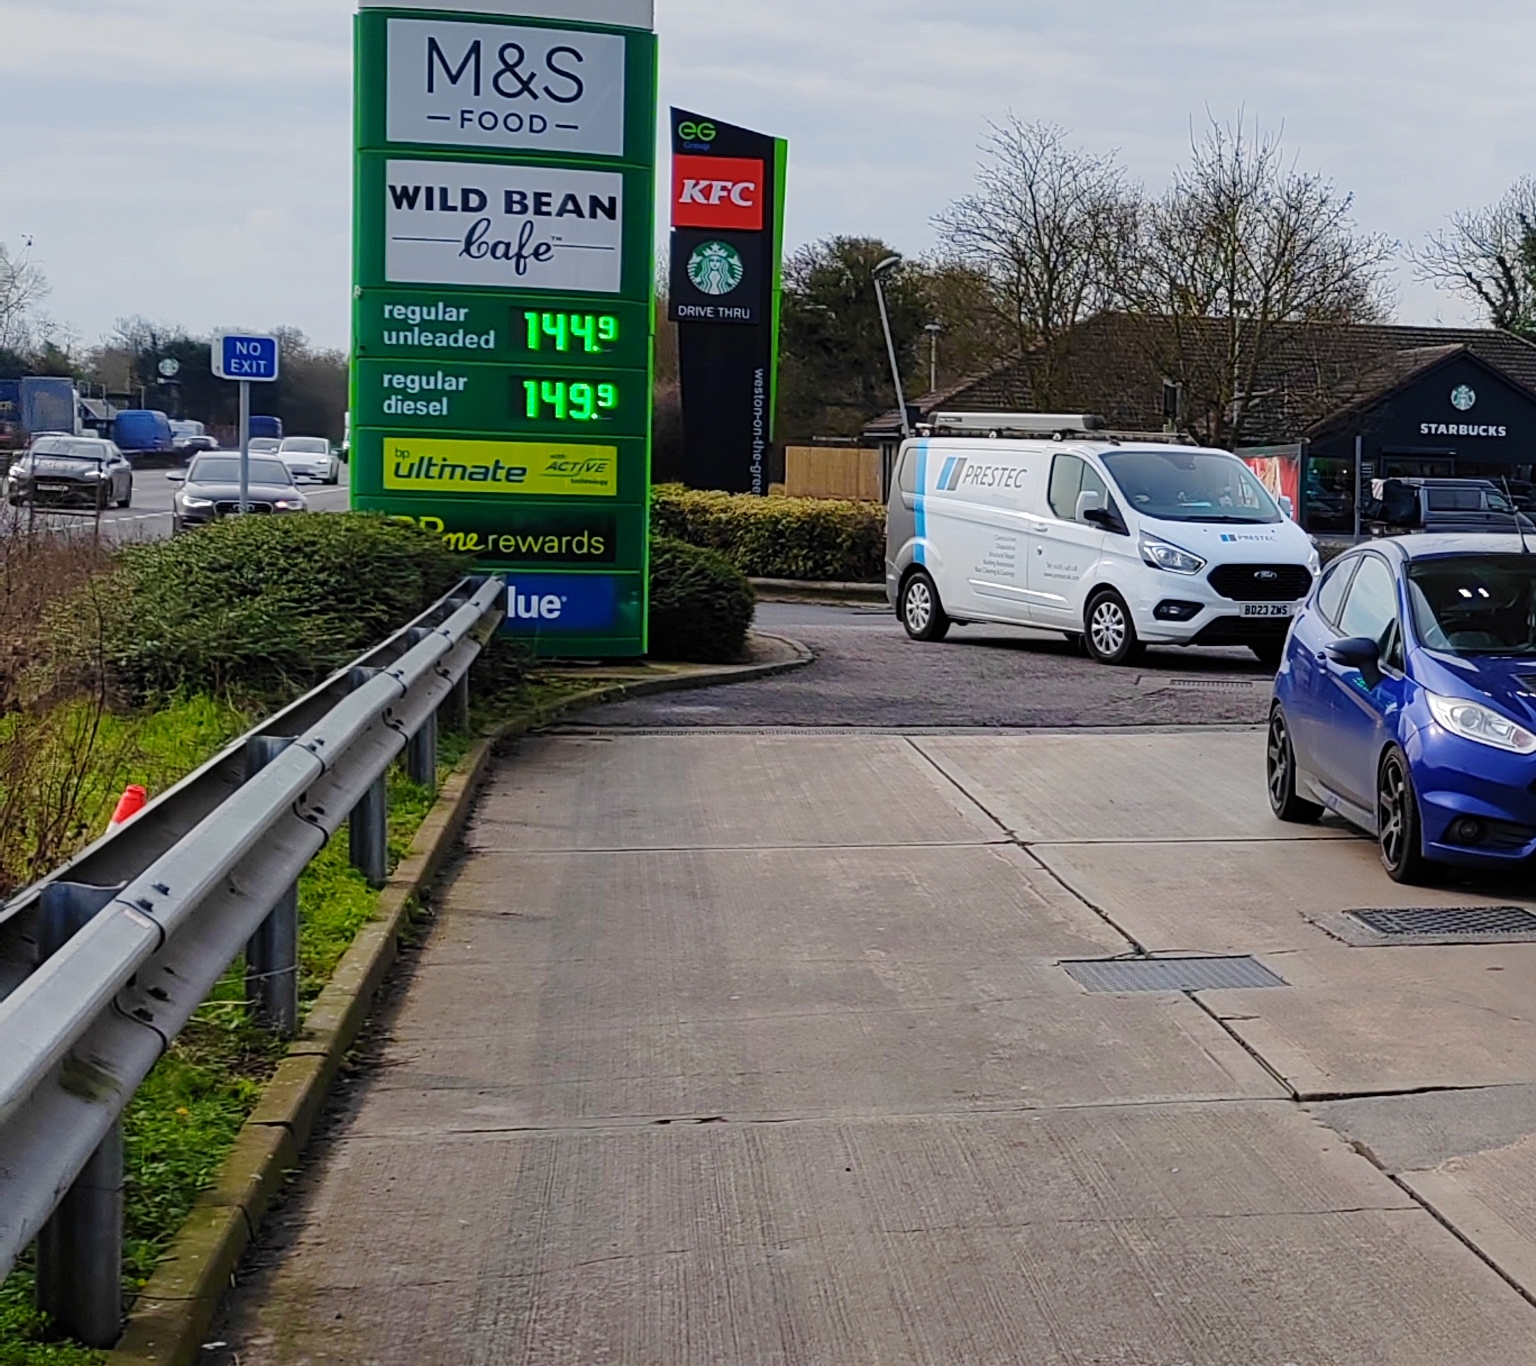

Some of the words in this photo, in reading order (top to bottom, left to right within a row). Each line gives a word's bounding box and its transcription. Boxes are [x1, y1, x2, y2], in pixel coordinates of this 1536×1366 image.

[427, 36, 585, 104] M&S
[459, 109, 548, 134] FOOD
[387, 184, 488, 214] WILD
[503, 189, 618, 221] BEAN
[678, 178, 756, 207] KFC
[382, 302, 470, 325] regular
[677, 304, 716, 319] DRIVE
[716, 306, 751, 320] THRU
[235, 340, 262, 357] NO
[382, 326, 496, 349] unleaded
[230, 358, 268, 374] EXIT
[381, 370, 469, 394] regular
[381, 394, 449, 416] diesel
[1419, 422, 1507, 437] STARBUCKS
[394, 446, 410, 459] bp
[393, 455, 528, 484] ultimate
[962, 464, 1028, 489] PRESTEC
[487, 529, 606, 555] rewards
[1244, 604, 1269, 616] BD23
